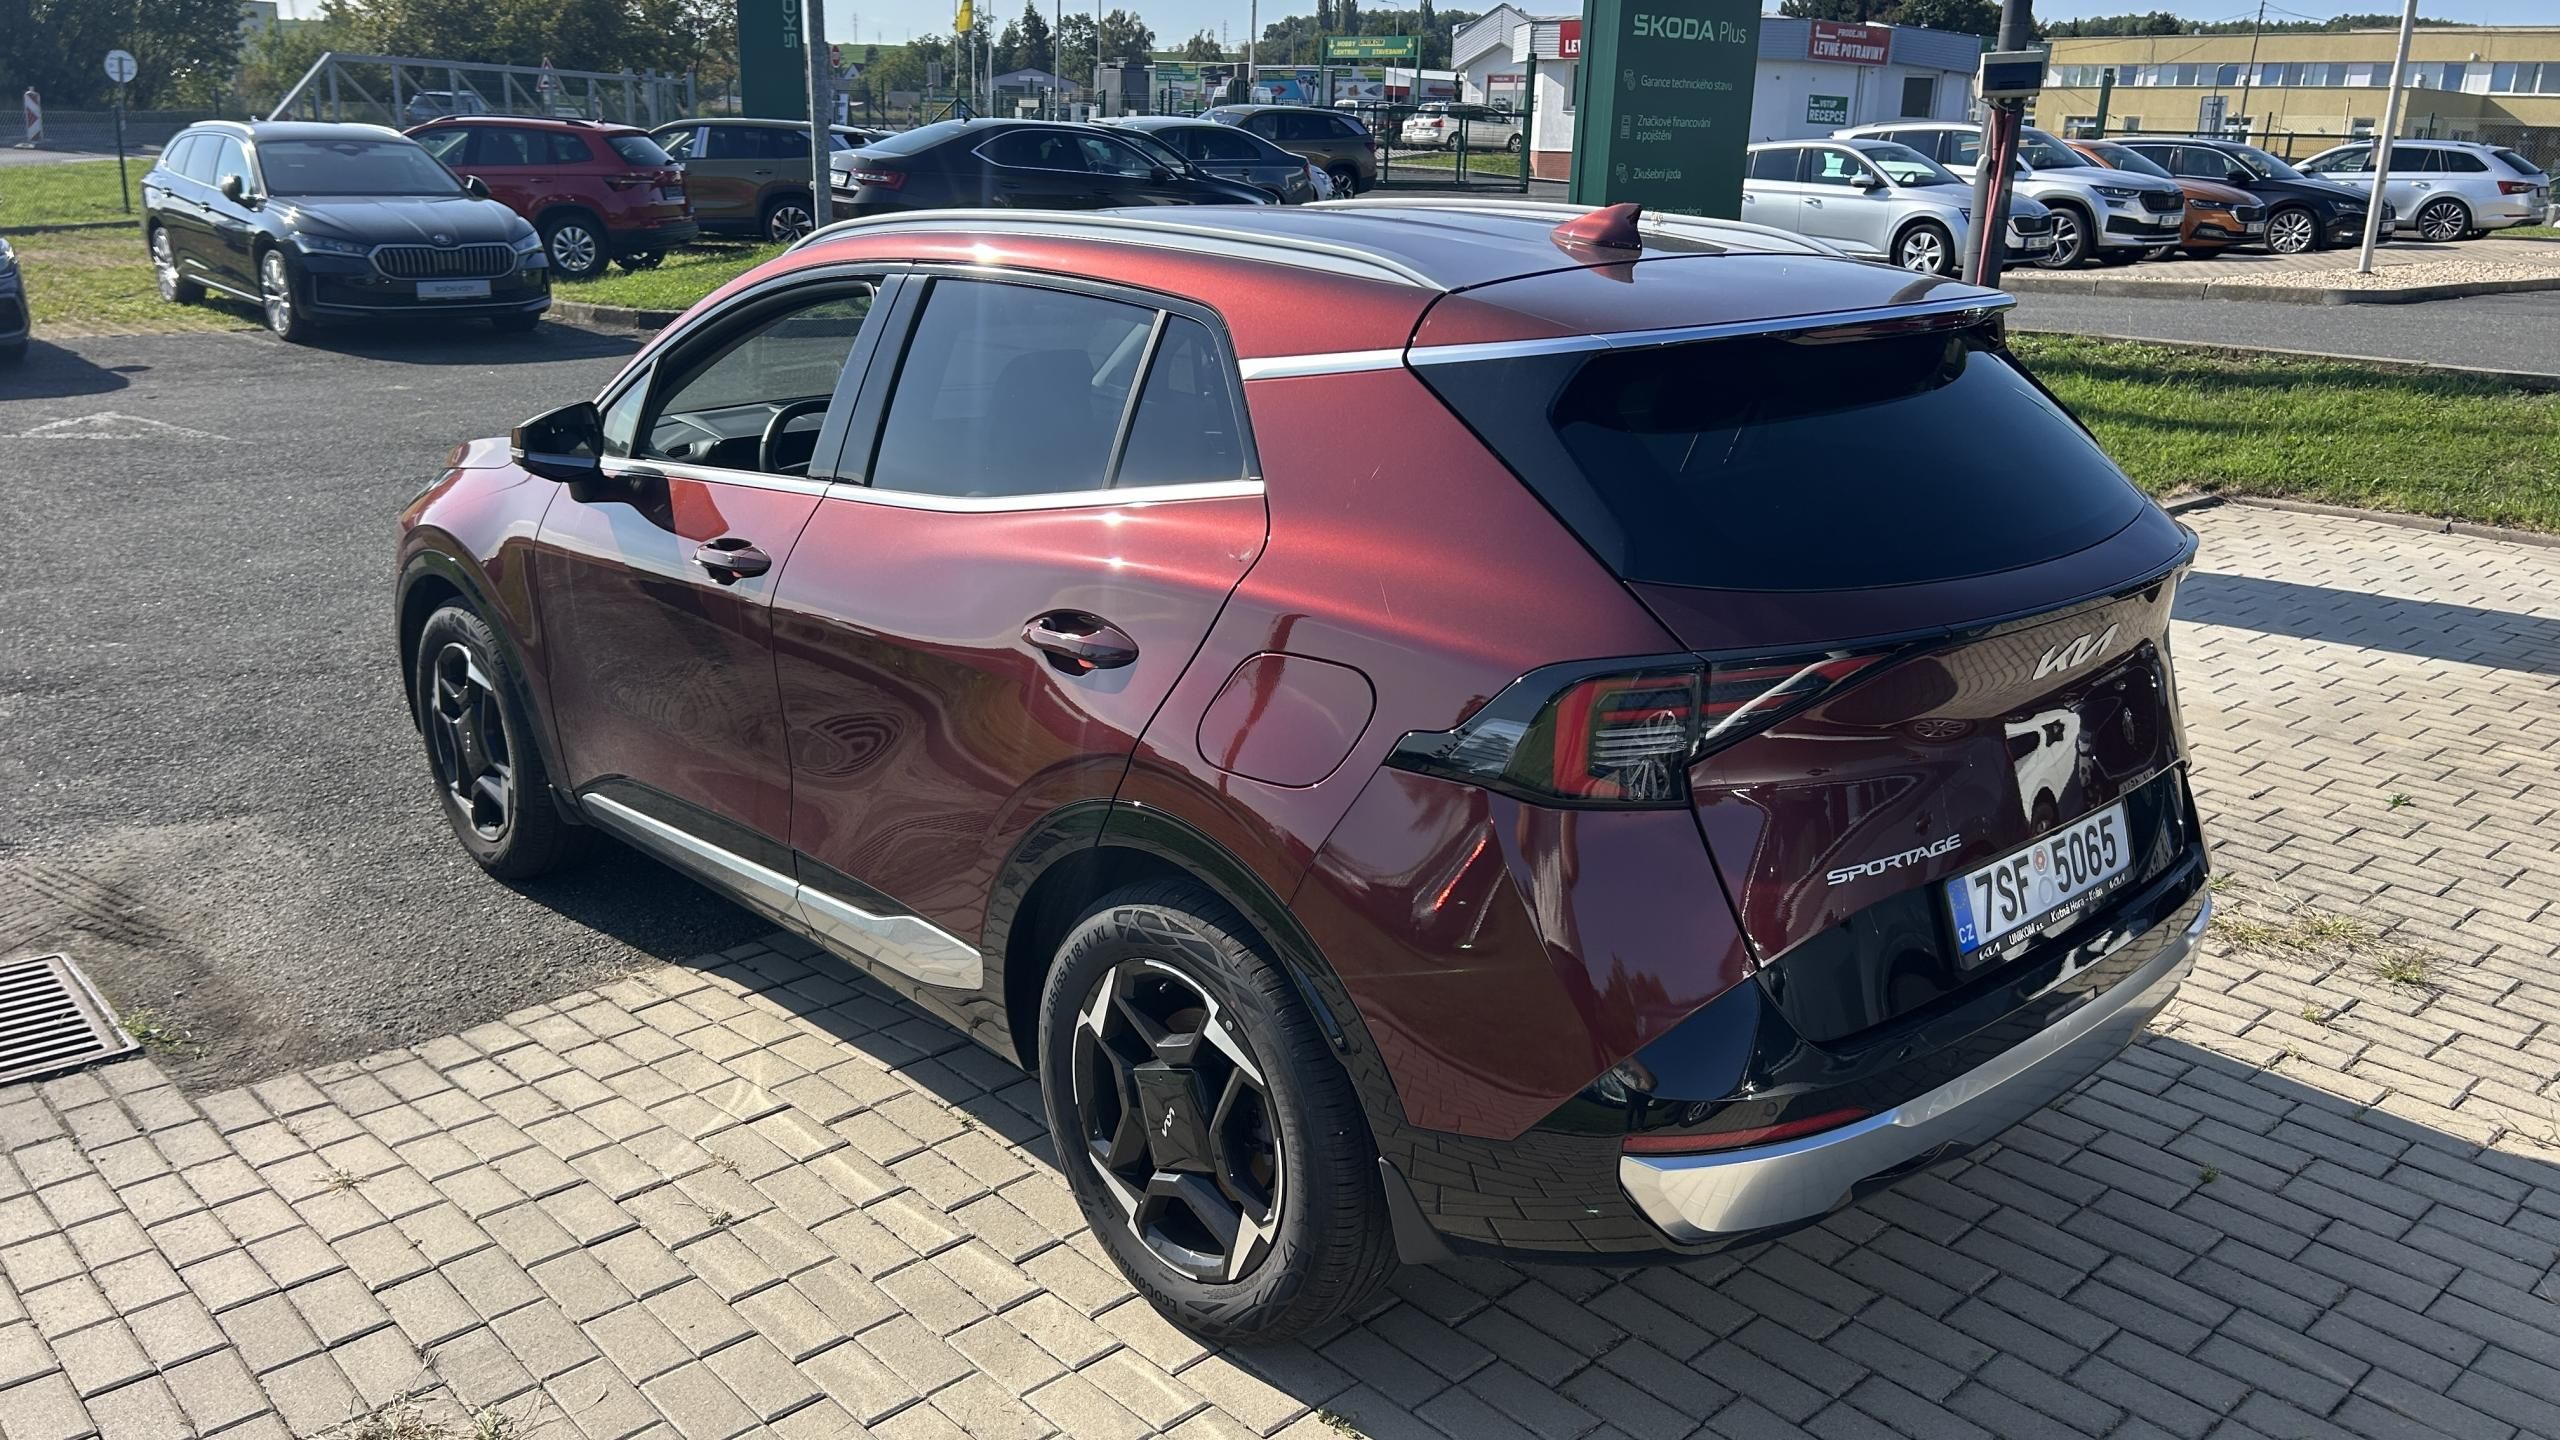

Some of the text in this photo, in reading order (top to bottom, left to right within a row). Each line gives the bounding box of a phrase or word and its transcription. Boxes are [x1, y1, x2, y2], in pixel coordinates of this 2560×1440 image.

[1719, 21, 1747, 44] Plus
[1813, 39, 1885, 61] LEVNÉ POTRAVINY
[1640, 74, 1671, 88] Garance
[1714, 81, 1733, 91] stavu
[1820, 99, 1837, 108] VSTUP
[1637, 114, 1672, 127] Značkové
[1808, 109, 1845, 123] RECEPCE
[1632, 167, 1665, 180] Zkušební
[1826, 833, 1962, 886] SPORTAGE
[1974, 815, 2117, 934] 7SF 5065
[1958, 923, 1975, 944] CZ
[2008, 922, 2036, 946] UNIKOM
[2050, 903, 2071, 923] Kutná
[1046, 966, 1066, 1019] 235/55
[1083, 933, 1093, 949] V
[1093, 925, 1110, 945] XL
[1108, 1243, 1178, 1315] EcoContact
